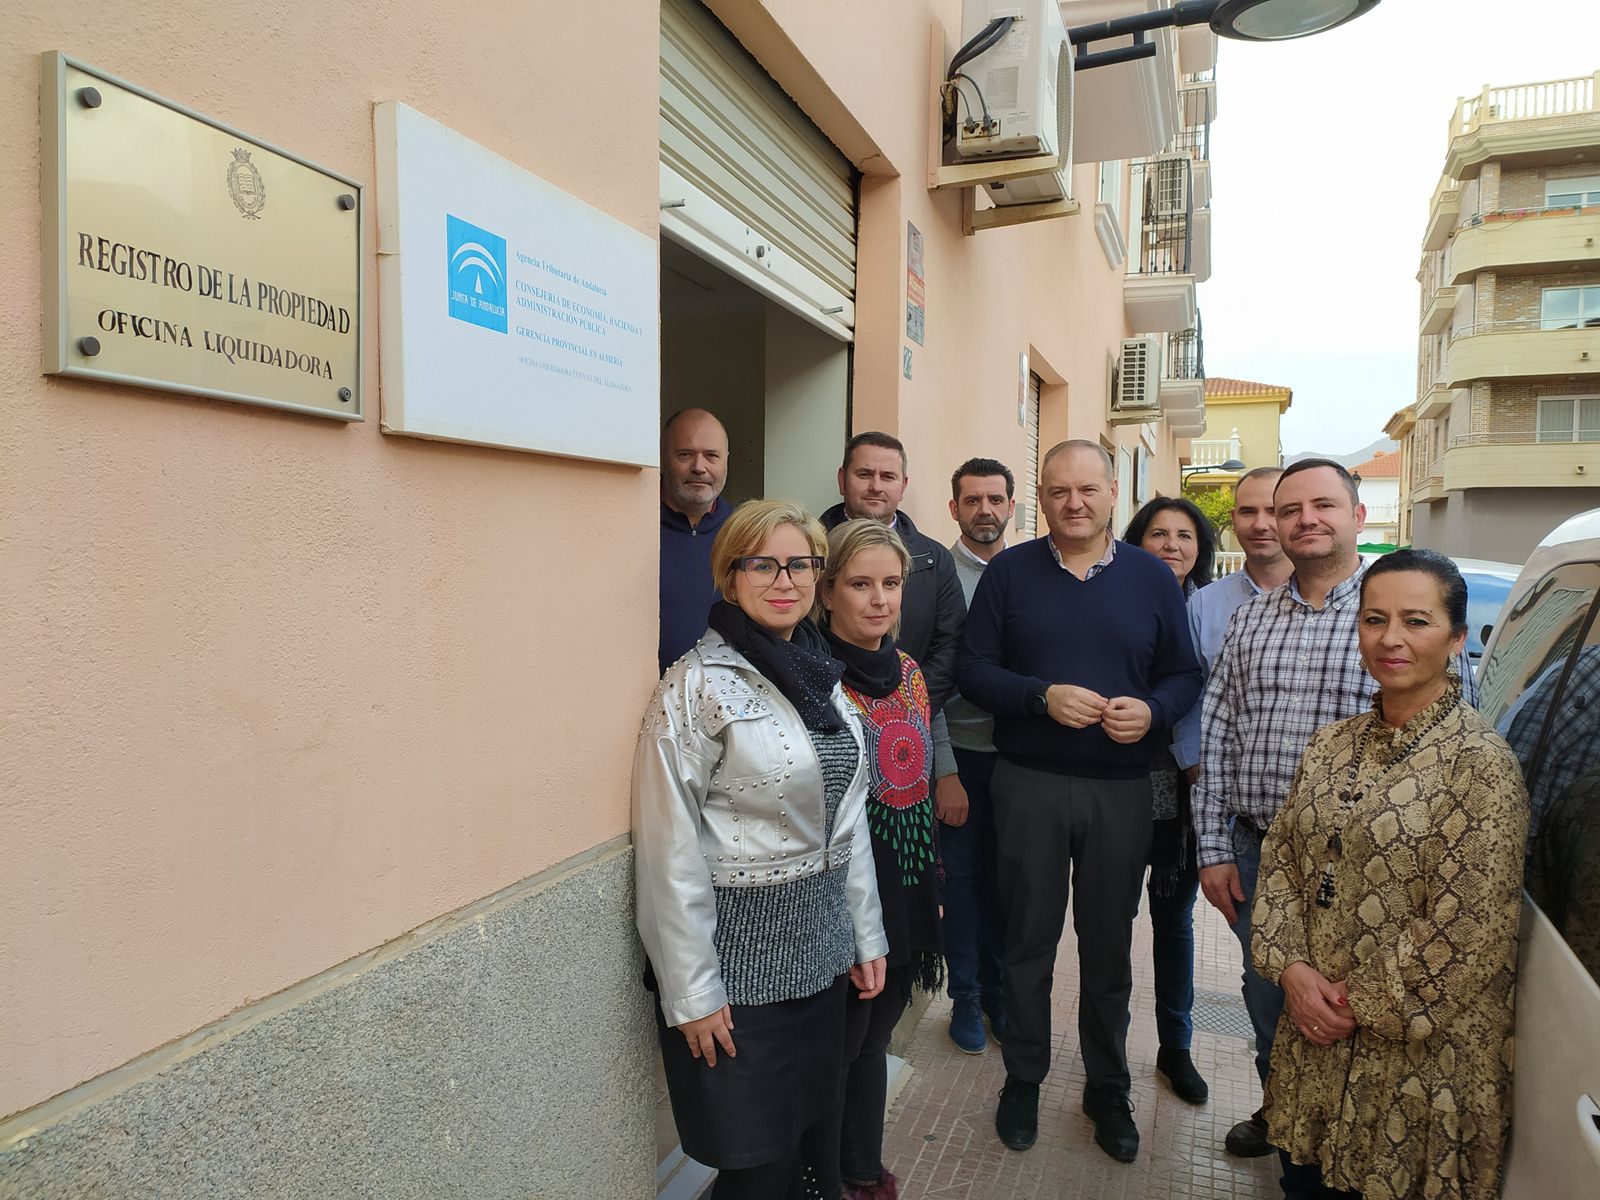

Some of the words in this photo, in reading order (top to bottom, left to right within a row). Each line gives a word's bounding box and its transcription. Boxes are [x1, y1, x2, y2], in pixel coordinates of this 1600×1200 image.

[77, 232, 191, 292] REGISTRO
[198, 264, 223, 301] DE
[227, 273, 251, 308] LA
[257, 281, 350, 334] PROPIEDAD
[516, 250, 540, 268] Agencia
[542, 261, 571, 282] Tributaria
[573, 275, 579, 284] de
[451, 291, 468, 304] JUNTA
[471, 297, 476, 307] DE
[562, 298, 570, 309] DE
[610, 316, 638, 334] HACIENDA
[639, 328, 643, 336] Y
[98, 309, 192, 347] OFICINA
[205, 330, 333, 380] LIQUIDADORA
[516, 326, 551, 344] GERENCIA
[552, 336, 589, 356] PROVINCIAL
[590, 348, 597, 358] EN
[518, 356, 538, 368] OFICINA
[594, 376, 602, 385] DEL
